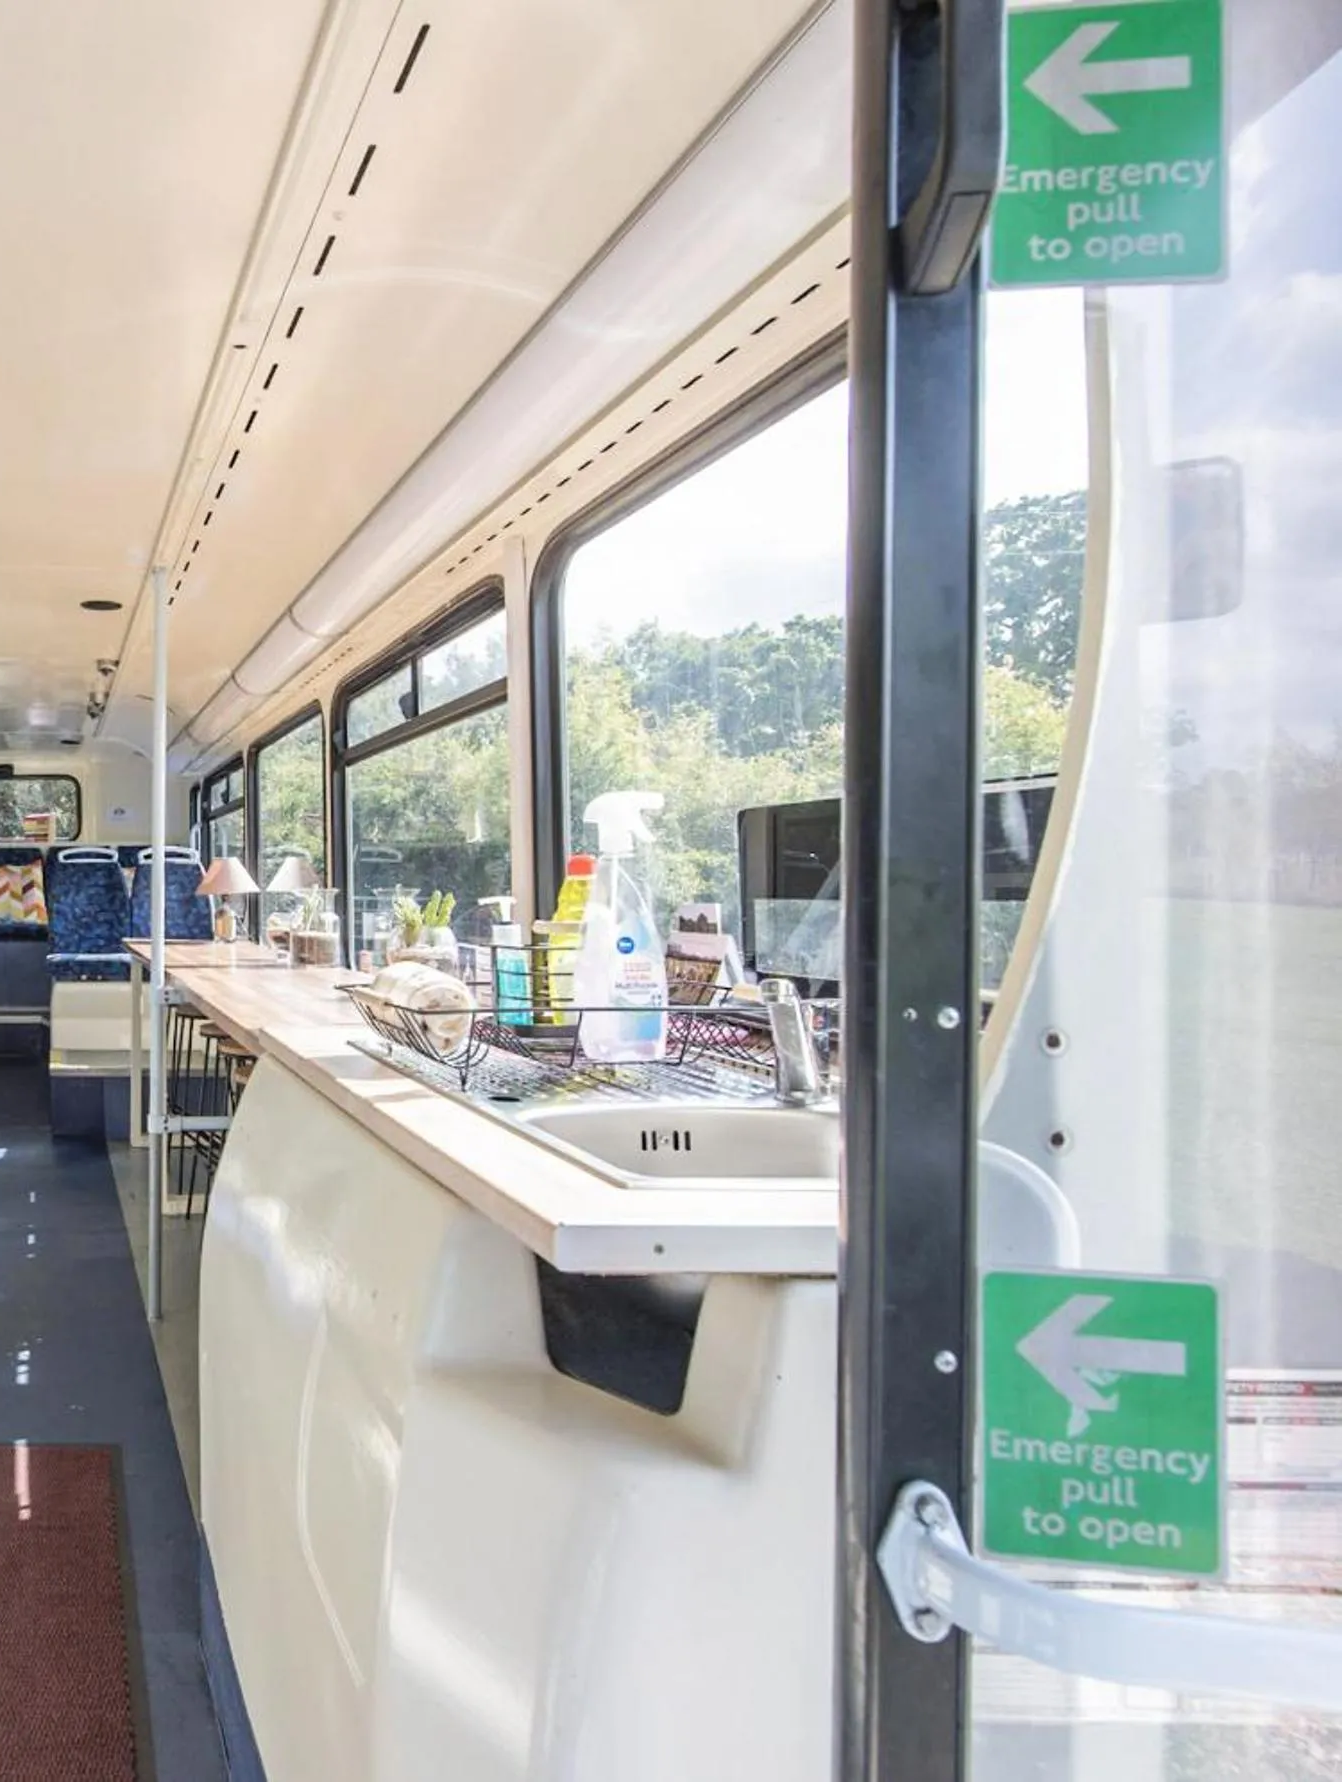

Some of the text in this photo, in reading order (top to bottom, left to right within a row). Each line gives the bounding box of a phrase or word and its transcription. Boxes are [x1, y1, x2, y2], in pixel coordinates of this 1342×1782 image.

[999, 159, 1214, 193] Emergency
[1067, 194, 1141, 231] pull
[1028, 231, 1184, 263] to open
[989, 1428, 1210, 1483] Emergency
[1062, 1477, 1138, 1509] pull
[1022, 1506, 1183, 1549] to open
